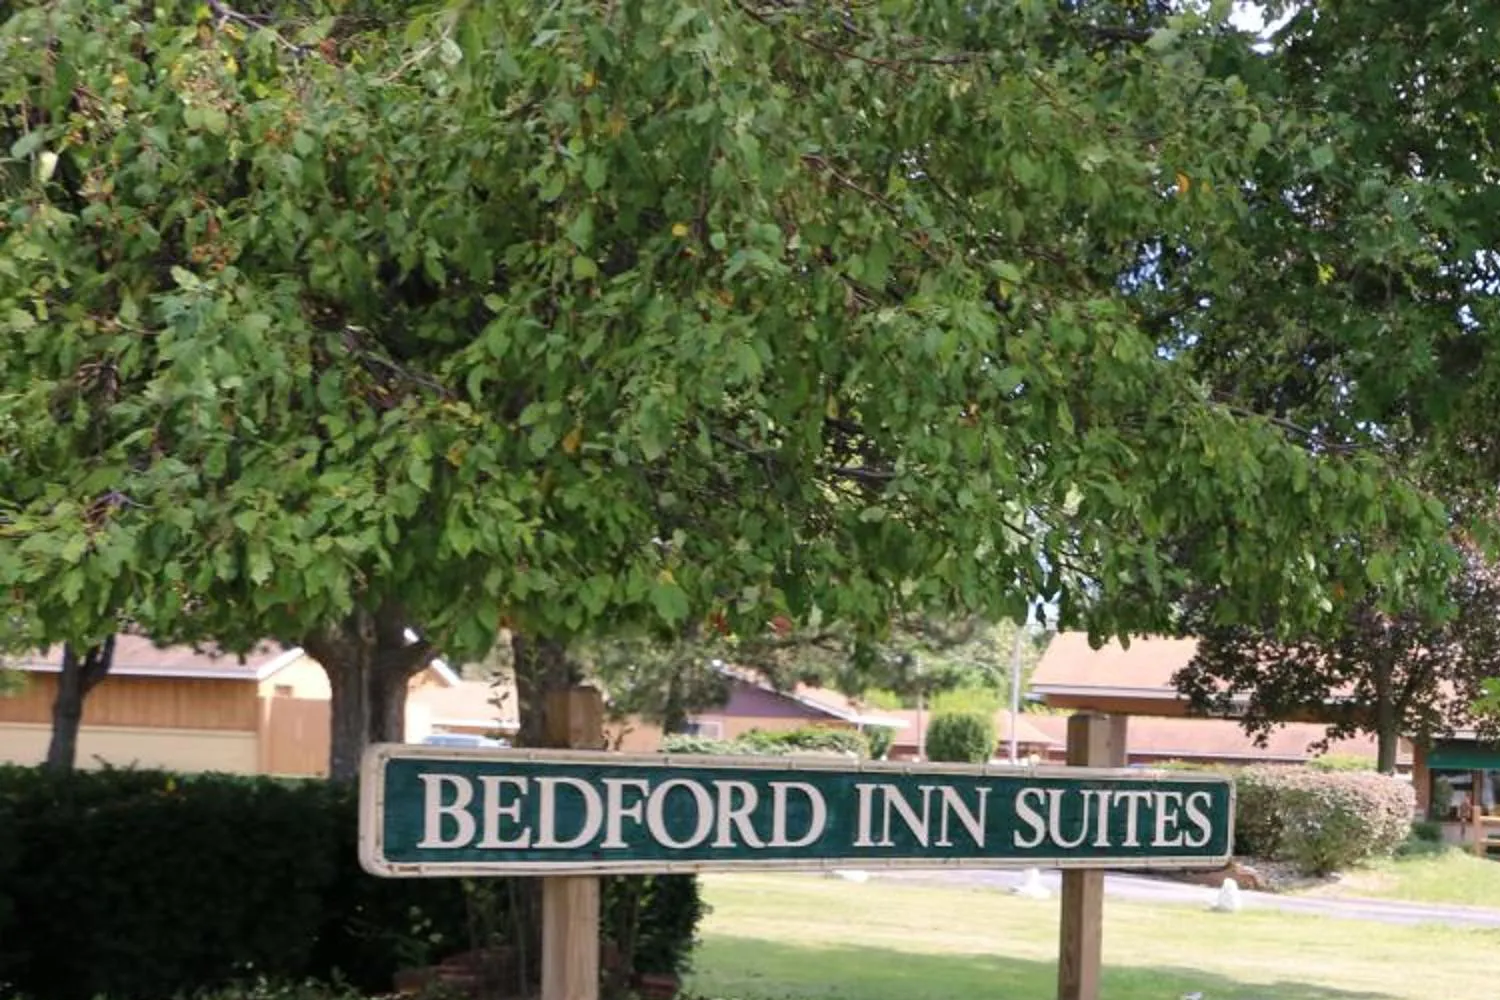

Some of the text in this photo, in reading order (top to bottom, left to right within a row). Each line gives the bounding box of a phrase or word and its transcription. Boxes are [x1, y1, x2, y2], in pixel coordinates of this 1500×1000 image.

[416, 773, 1212, 849] BEDFORD INN SUITES
